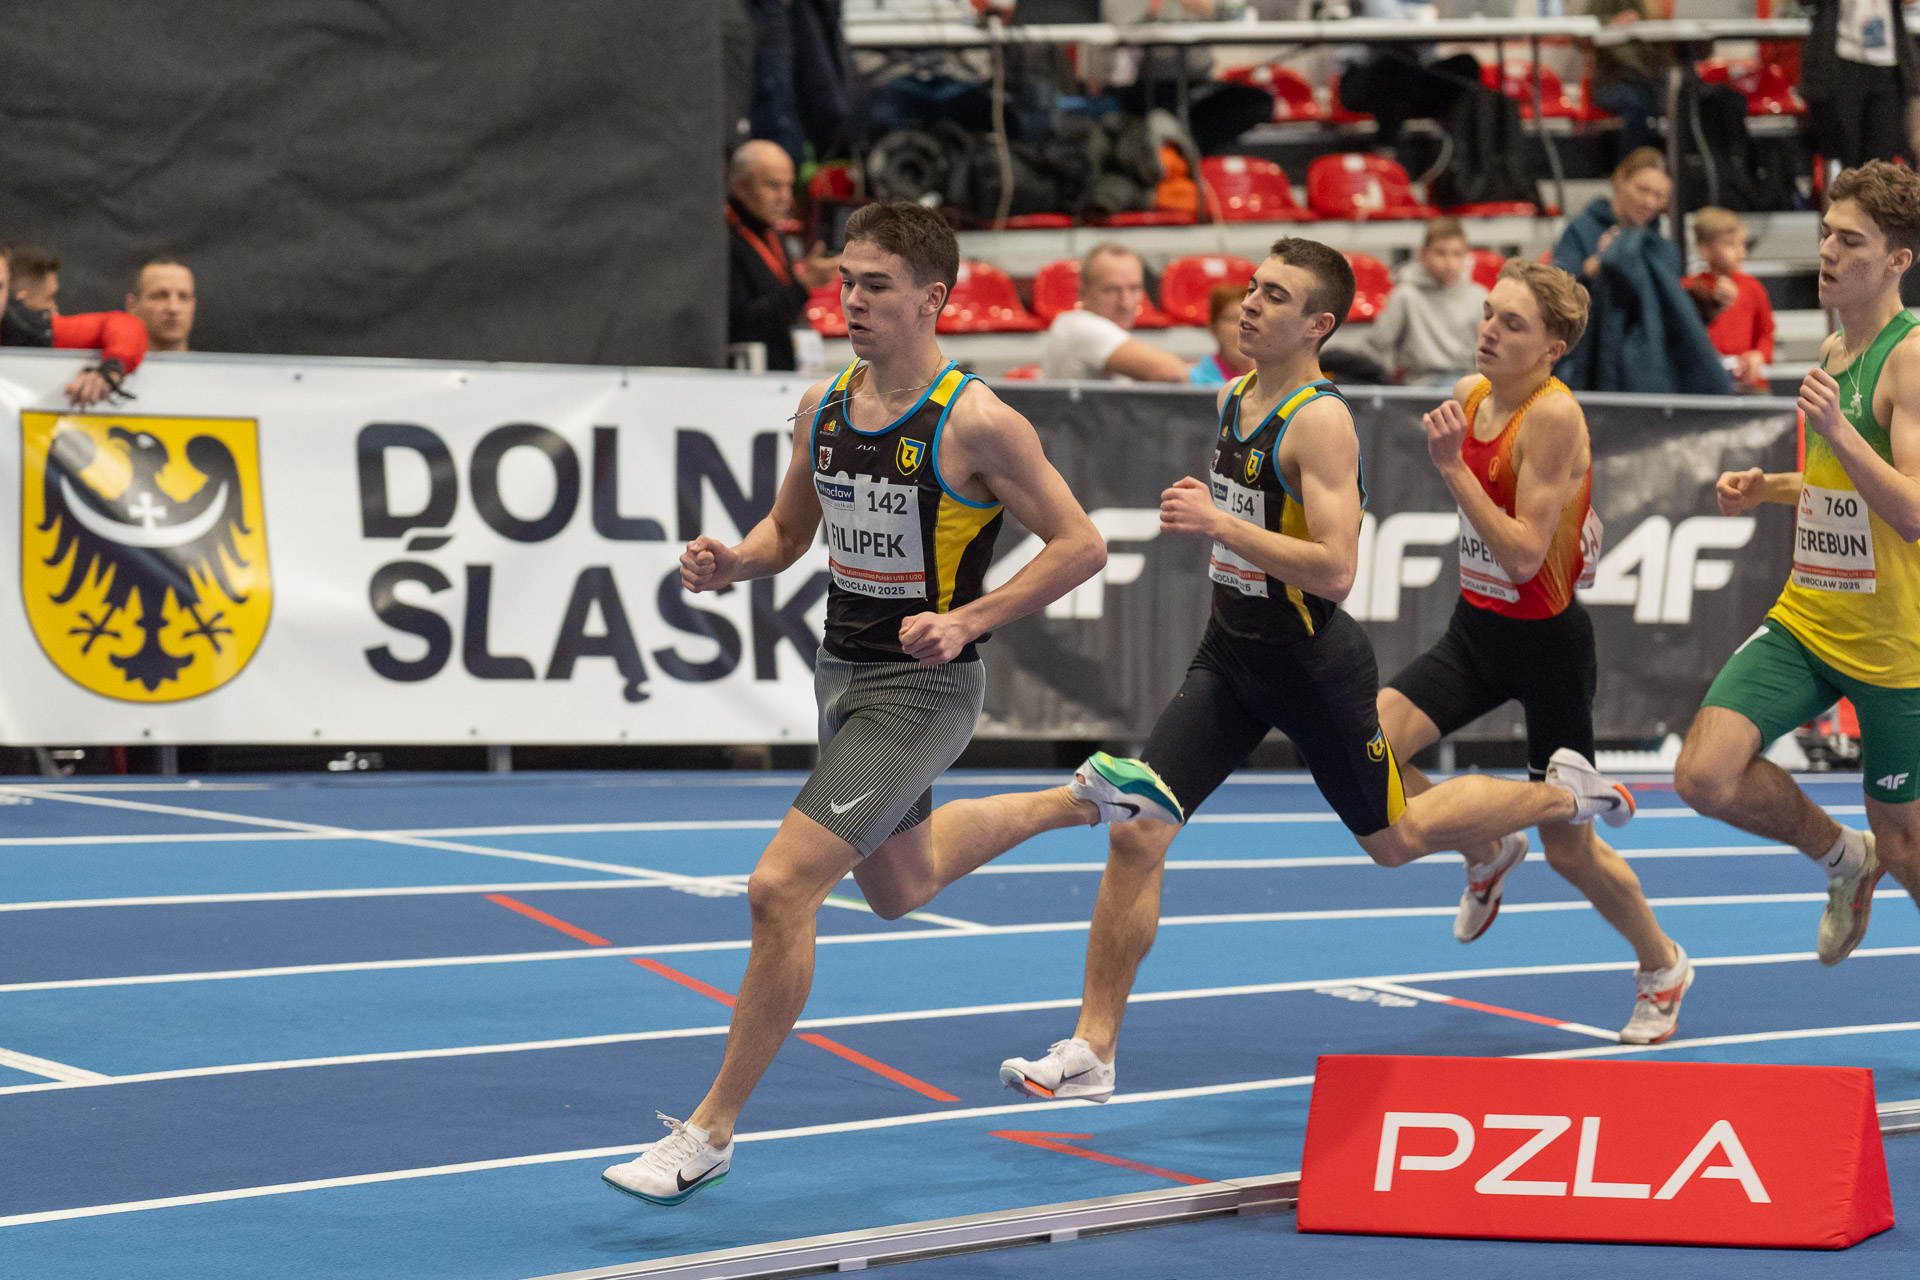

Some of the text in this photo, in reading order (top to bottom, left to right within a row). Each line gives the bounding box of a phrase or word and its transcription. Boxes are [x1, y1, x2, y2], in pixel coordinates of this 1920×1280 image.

[355, 421, 828, 544] DOLN
[818, 481, 852, 499] Wrocław
[867, 490, 908, 515] 142
[1231, 491, 1255, 517] 154
[1825, 496, 1858, 517] 760
[831, 522, 907, 558] FILIPEK
[1460, 535, 1500, 567] APE
[1797, 527, 1868, 557] TEREBUN
[1577, 515, 1757, 625] 4F
[837, 577, 906, 594] WROCŁAW 2025
[1838, 581, 1860, 591] 2025
[364, 532, 829, 704] ŚLĄSK
[1876, 771, 1910, 791] 4F
[1373, 1110, 1772, 1205] PZLA
